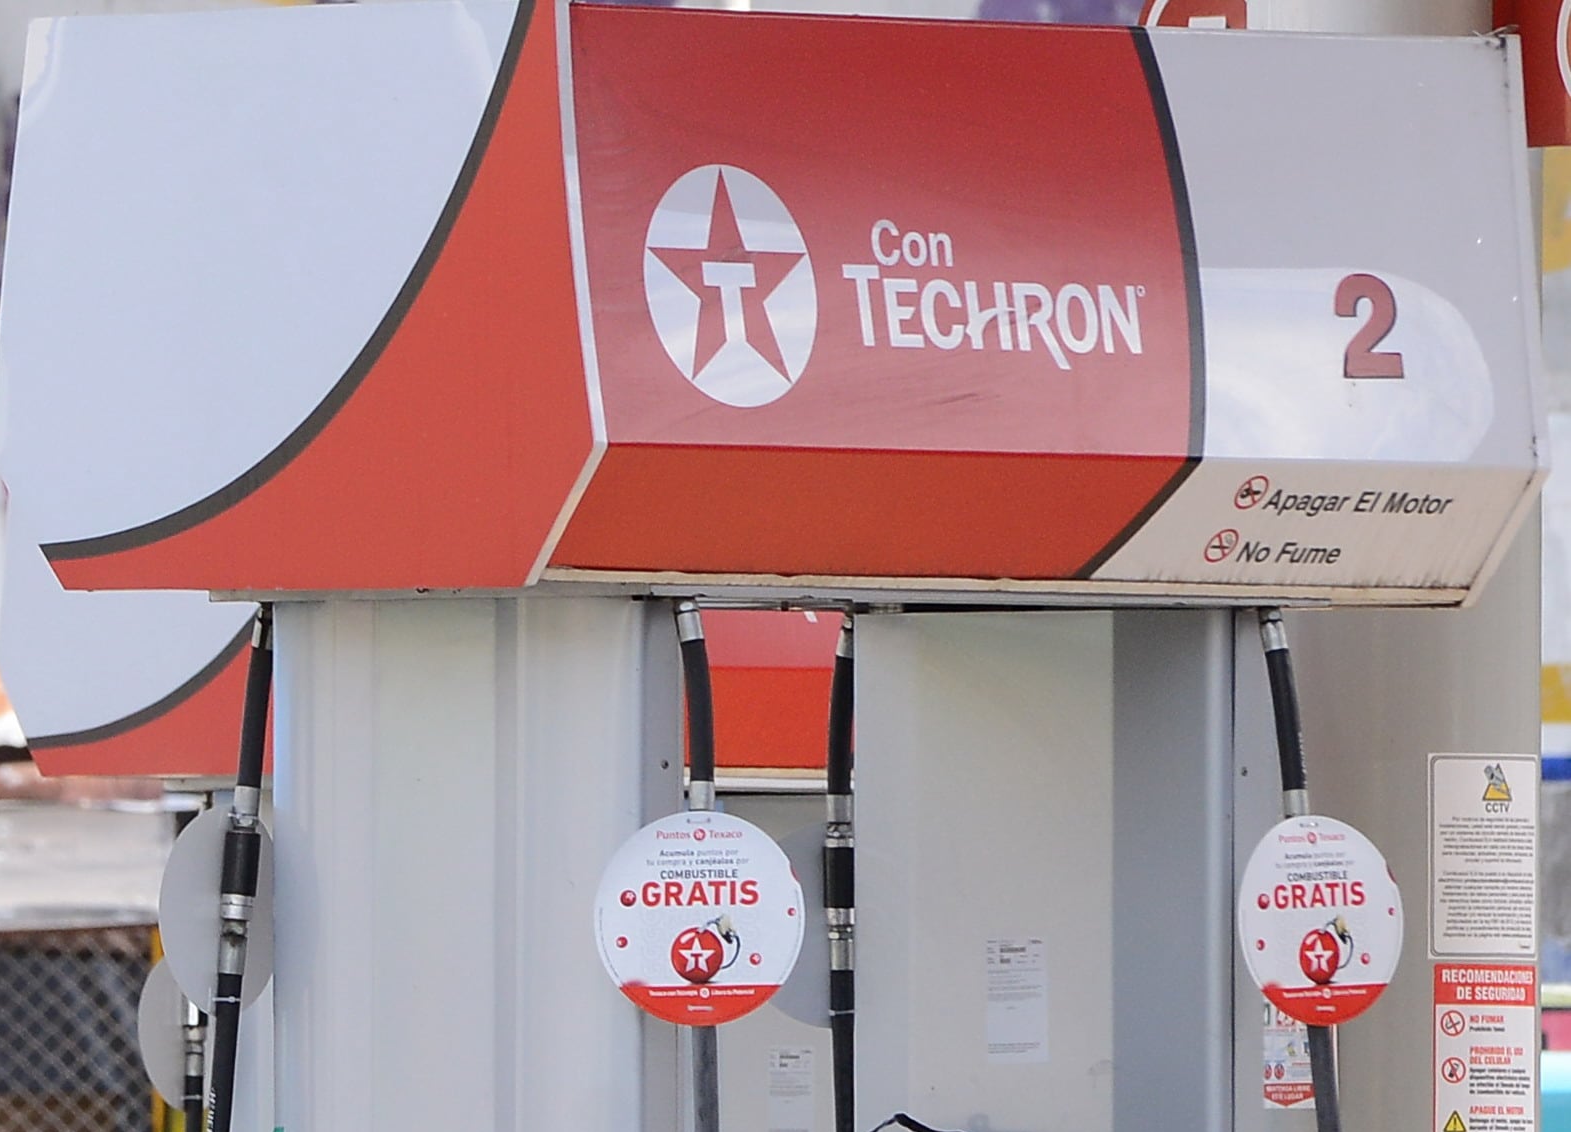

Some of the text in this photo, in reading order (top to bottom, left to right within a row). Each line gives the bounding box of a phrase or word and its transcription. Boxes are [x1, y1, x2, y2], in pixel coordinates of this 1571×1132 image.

[870, 218, 954, 267] Con
[1333, 273, 1405, 380] 2
[1262, 488, 1454, 517] Apagar El Motor
[1235, 541, 1342, 565] No Fume
[1485, 802, 1510, 813] CCTV
[656, 829, 743, 839] Puntos Texaco
[659, 849, 695, 857] Acumula
[659, 868, 739, 880] COMBUSTIBLE
[1287, 870, 1348, 882] COMBUSTIBLE
[641, 880, 760, 907] GRATIS
[1274, 881, 1366, 909] GRATIS
[1441, 969, 1533, 985] RECOMENDACIONES
[1456, 986, 1526, 1001] DE SEGURIDAD
[1469, 1015, 1504, 1024] NO FUMAR
[1469, 1056, 1511, 1065] DEL CELULAR
[1469, 1106, 1496, 1115] APAGUE
